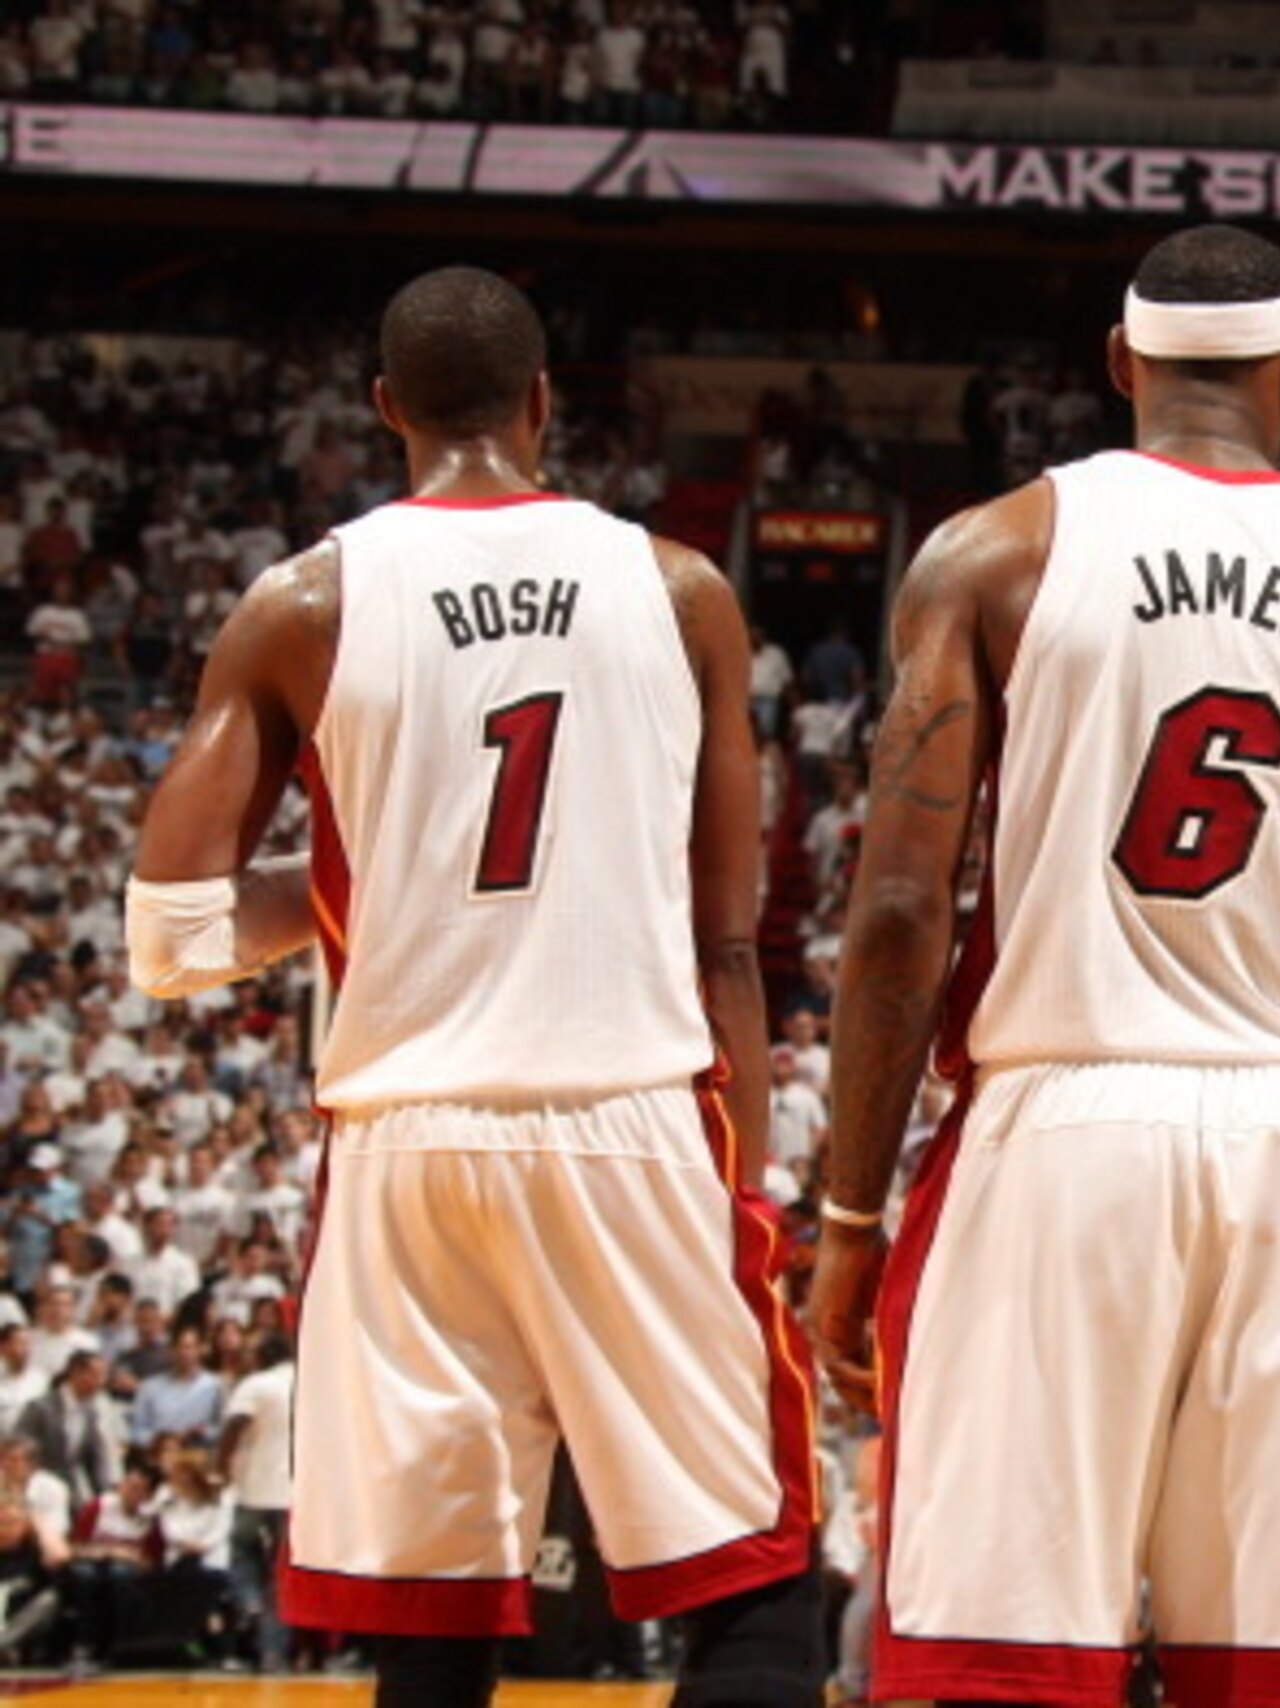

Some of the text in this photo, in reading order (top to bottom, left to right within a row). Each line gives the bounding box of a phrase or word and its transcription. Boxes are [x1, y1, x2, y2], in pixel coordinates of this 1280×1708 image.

[926, 142, 1186, 211] MAKE
[431, 578, 580, 651] BOSH
[472, 689, 565, 894] 1
